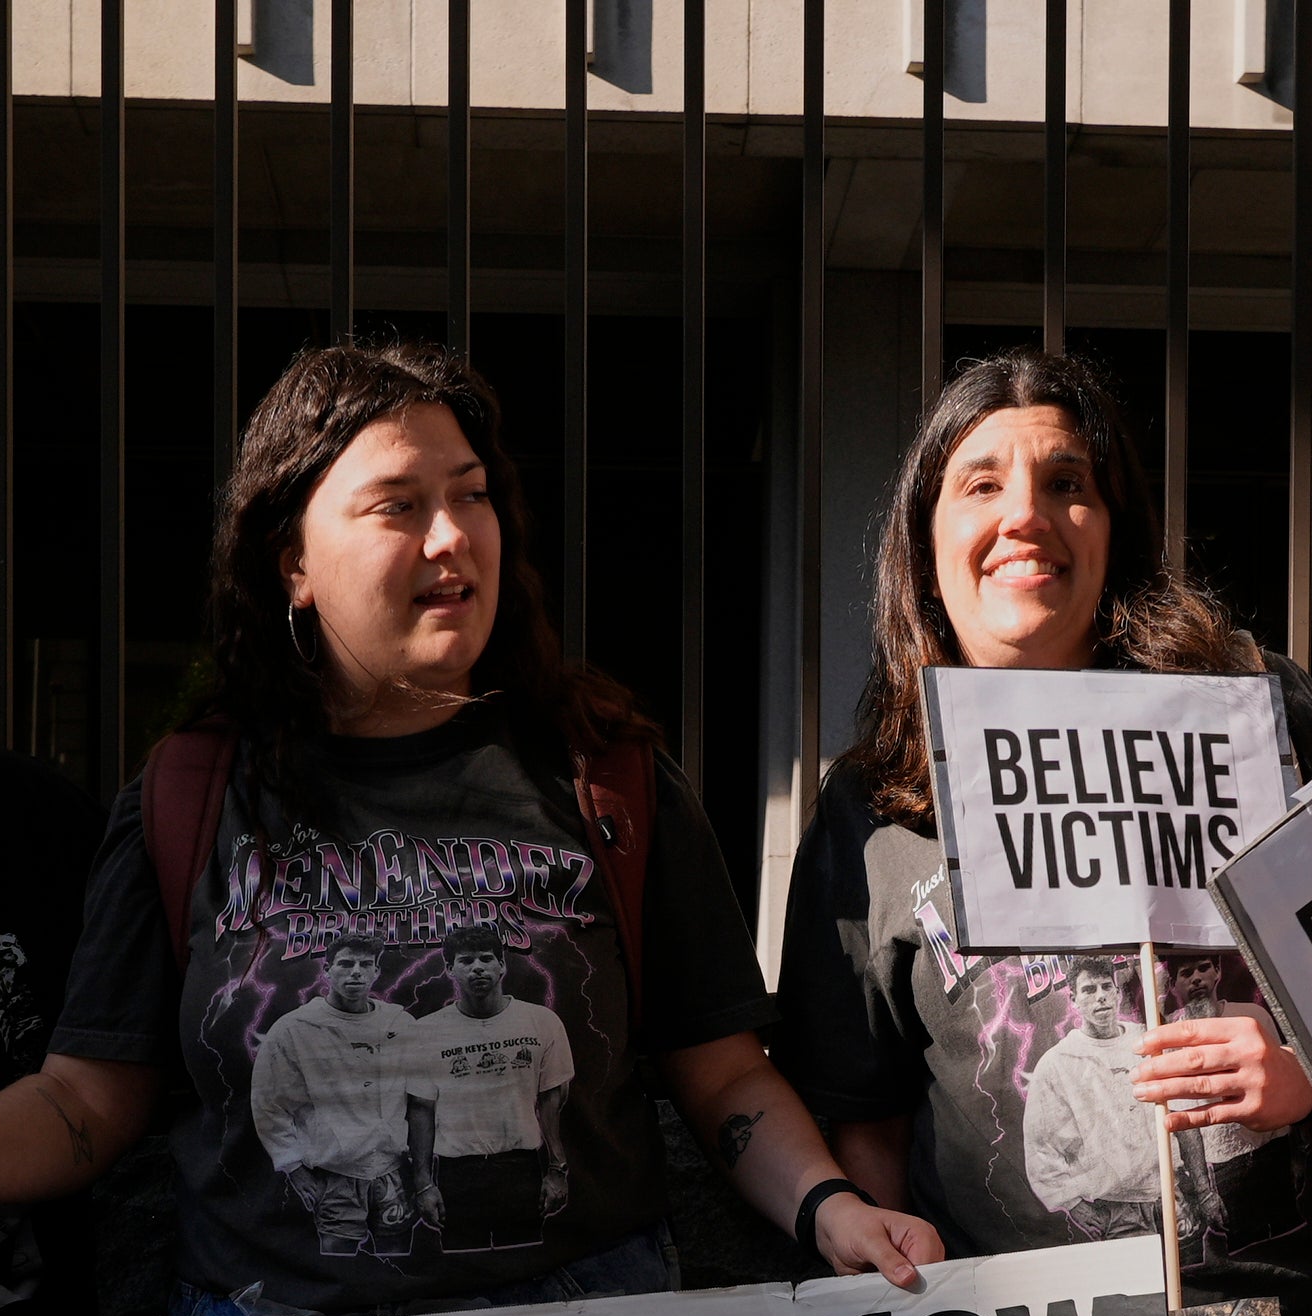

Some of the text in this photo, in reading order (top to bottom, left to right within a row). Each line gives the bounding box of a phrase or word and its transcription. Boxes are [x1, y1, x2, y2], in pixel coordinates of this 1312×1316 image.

[983, 729, 1237, 809] BELIEVE
[215, 829, 596, 943] MENENDEZ
[996, 810, 1240, 889] VICTIMS
[281, 899, 532, 961] BROTHERS
[441, 1037, 541, 1058] FOUR KEYS TO SUCCESS.
